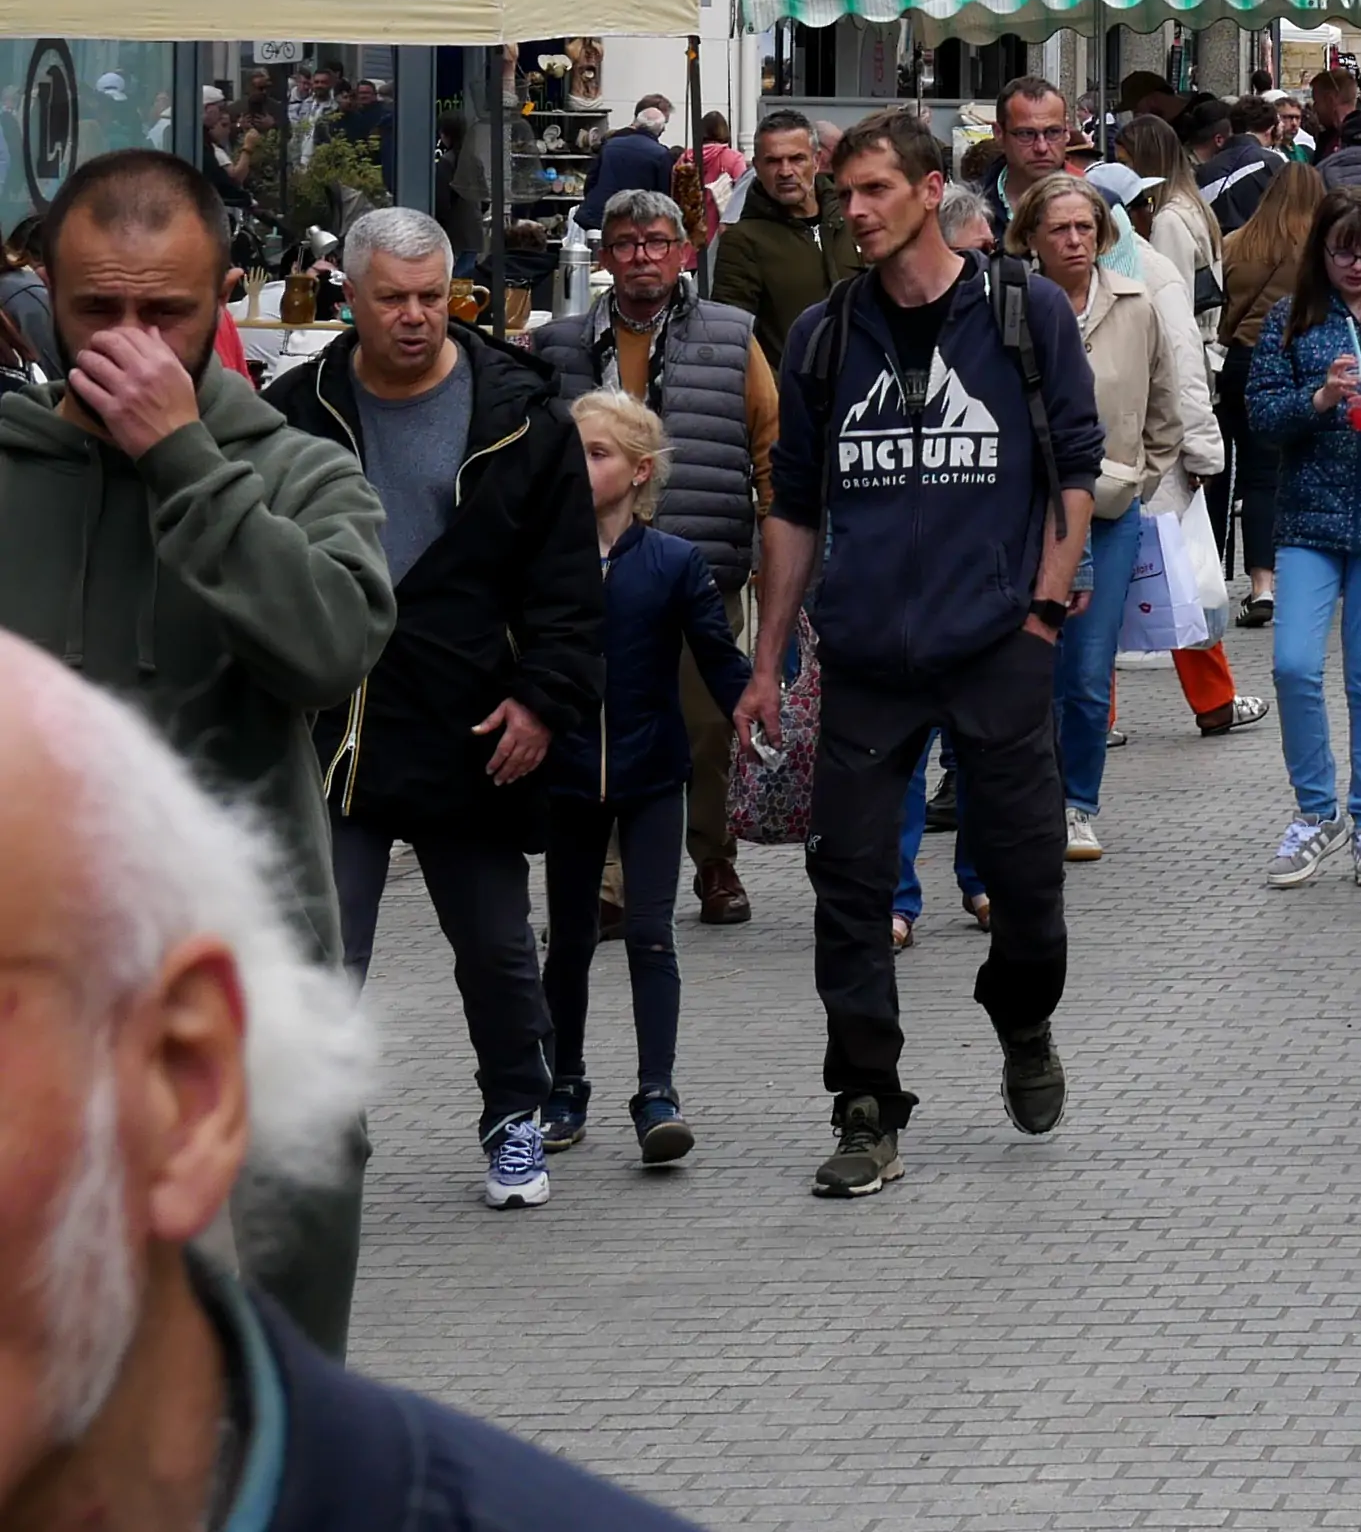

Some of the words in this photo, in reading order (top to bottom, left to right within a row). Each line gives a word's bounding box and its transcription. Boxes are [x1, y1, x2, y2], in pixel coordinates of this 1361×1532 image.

[838, 437, 999, 472] PICTURE
[842, 474, 907, 489] ORGANIC
[921, 473, 997, 485] CLOTHING
